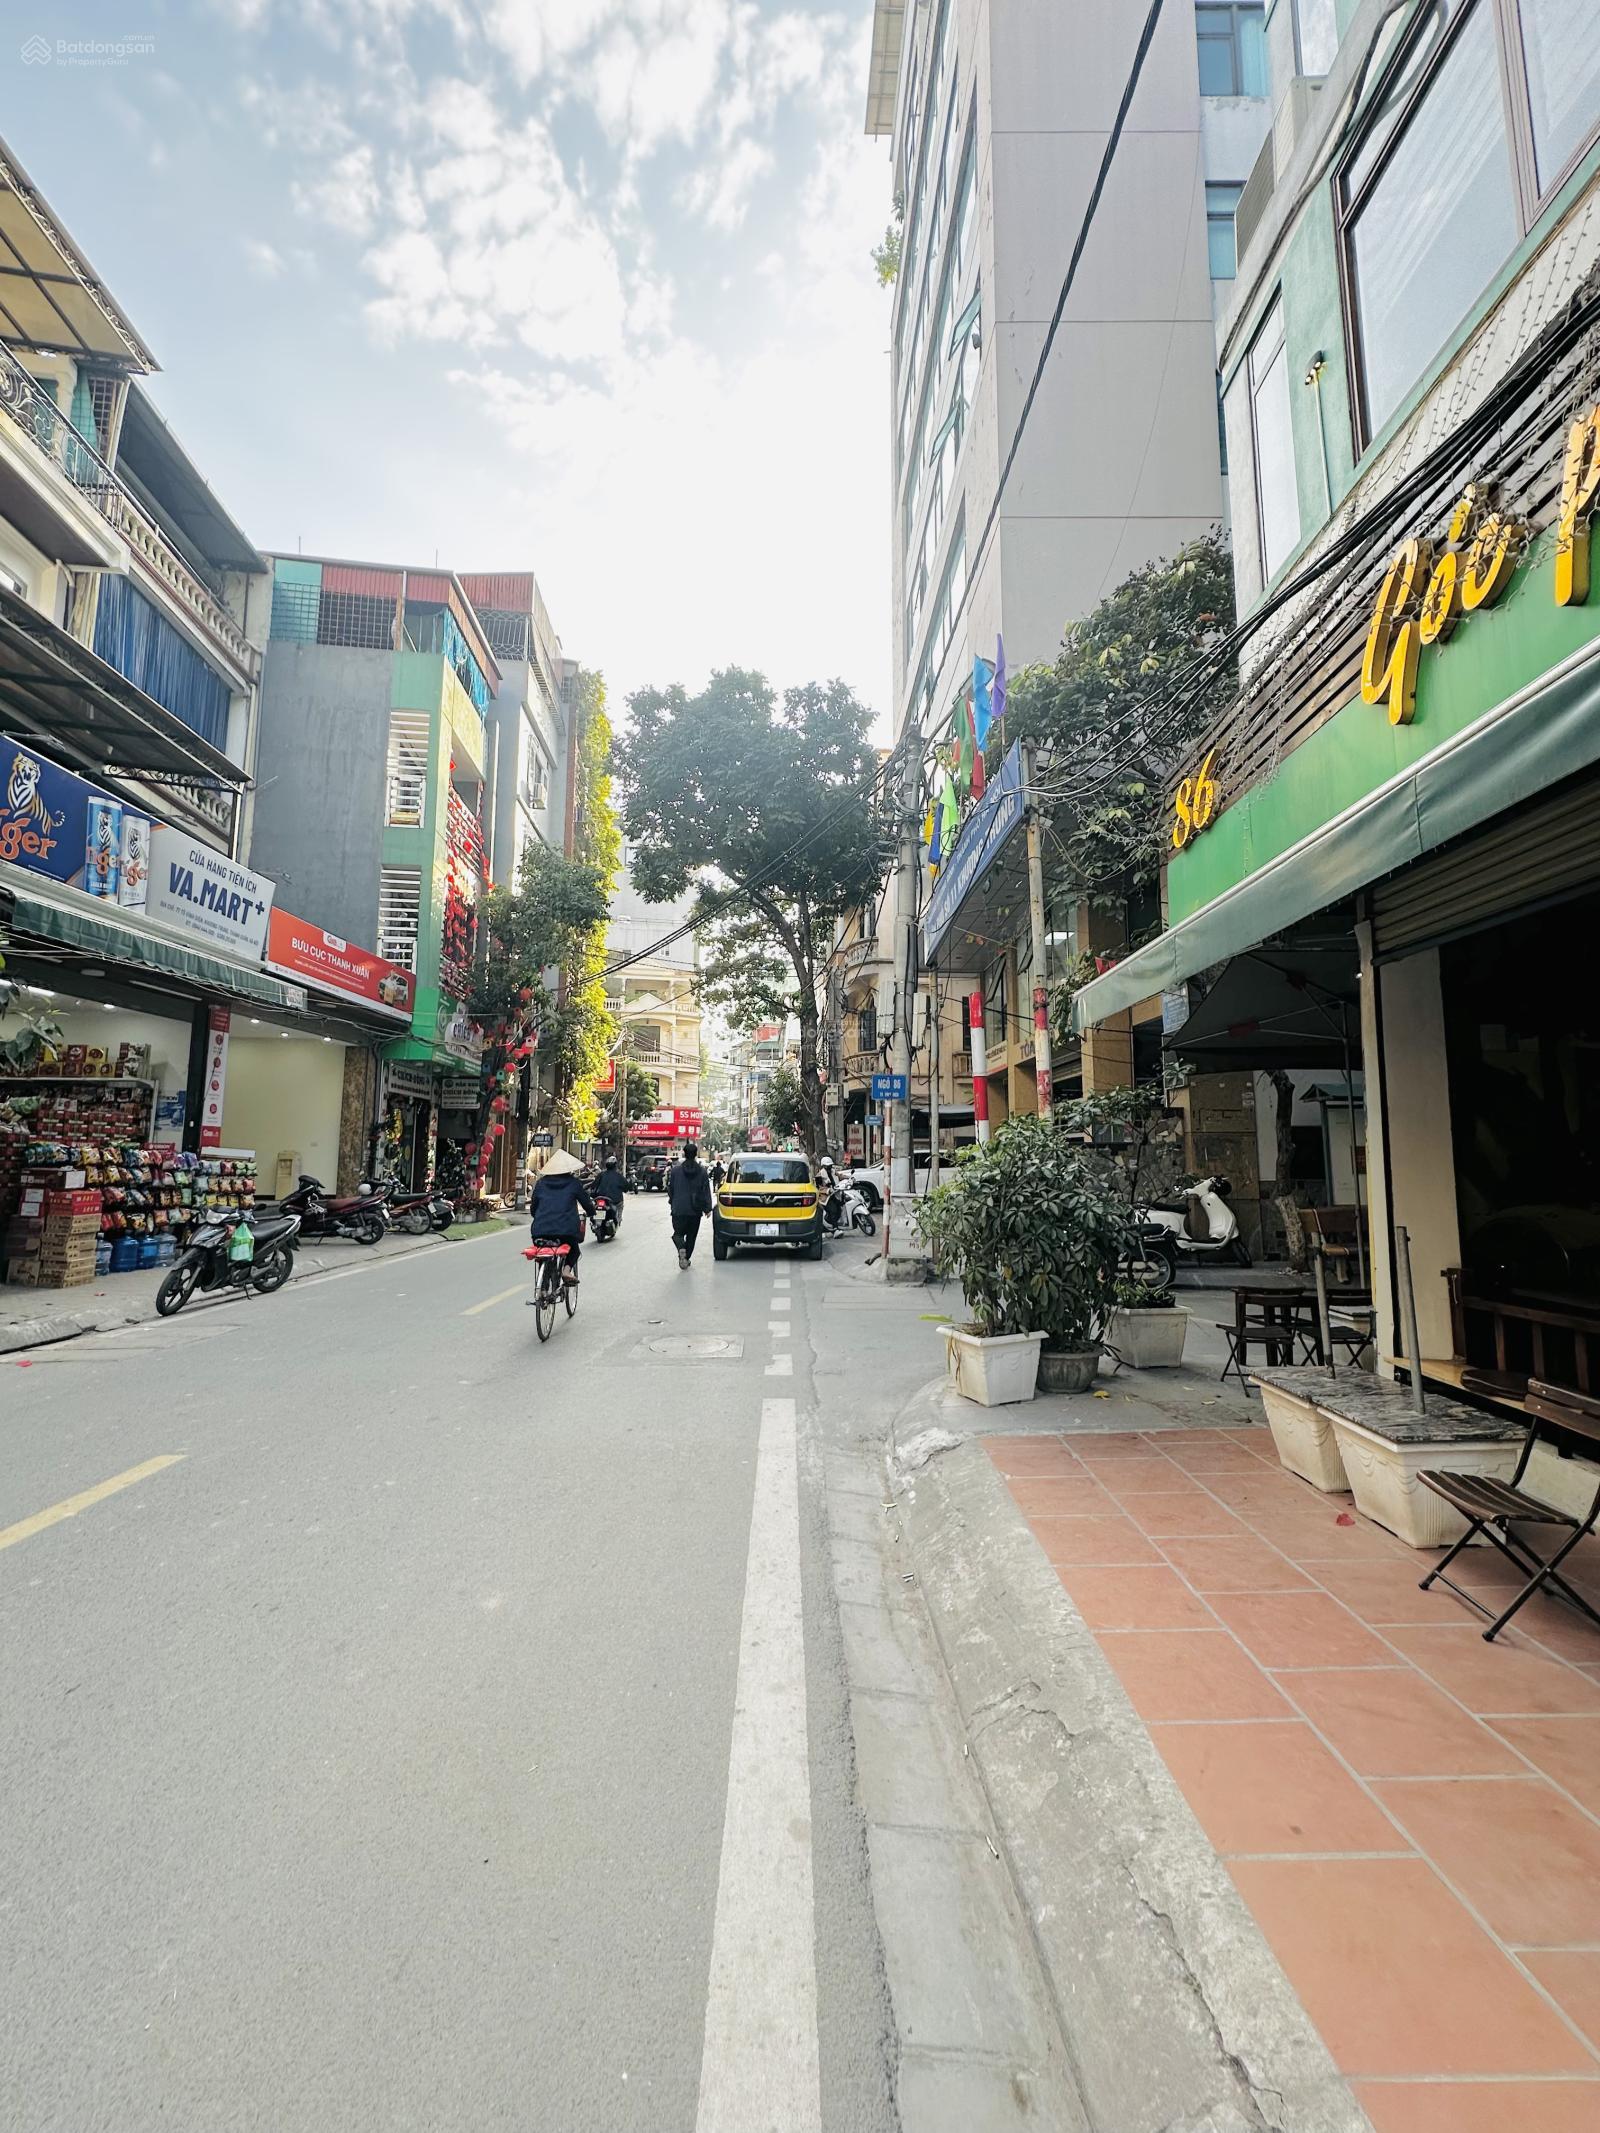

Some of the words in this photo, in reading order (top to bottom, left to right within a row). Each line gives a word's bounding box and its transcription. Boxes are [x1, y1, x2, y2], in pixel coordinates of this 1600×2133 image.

[1172, 748, 1218, 849] 86
[0, 808, 58, 860] ger
[189, 849, 205, 867] CỬA
[206, 858, 227, 879] HÀNG
[229, 869, 245, 889] TIỆN
[245, 880, 257, 894] ÍCH
[291, 937, 309, 954] BƯU
[310, 945, 326, 961] CỤC
[327, 952, 351, 971] THANH
[352, 964, 370, 980] XUÂN
[877, 1076, 890, 1089] NGÕ
